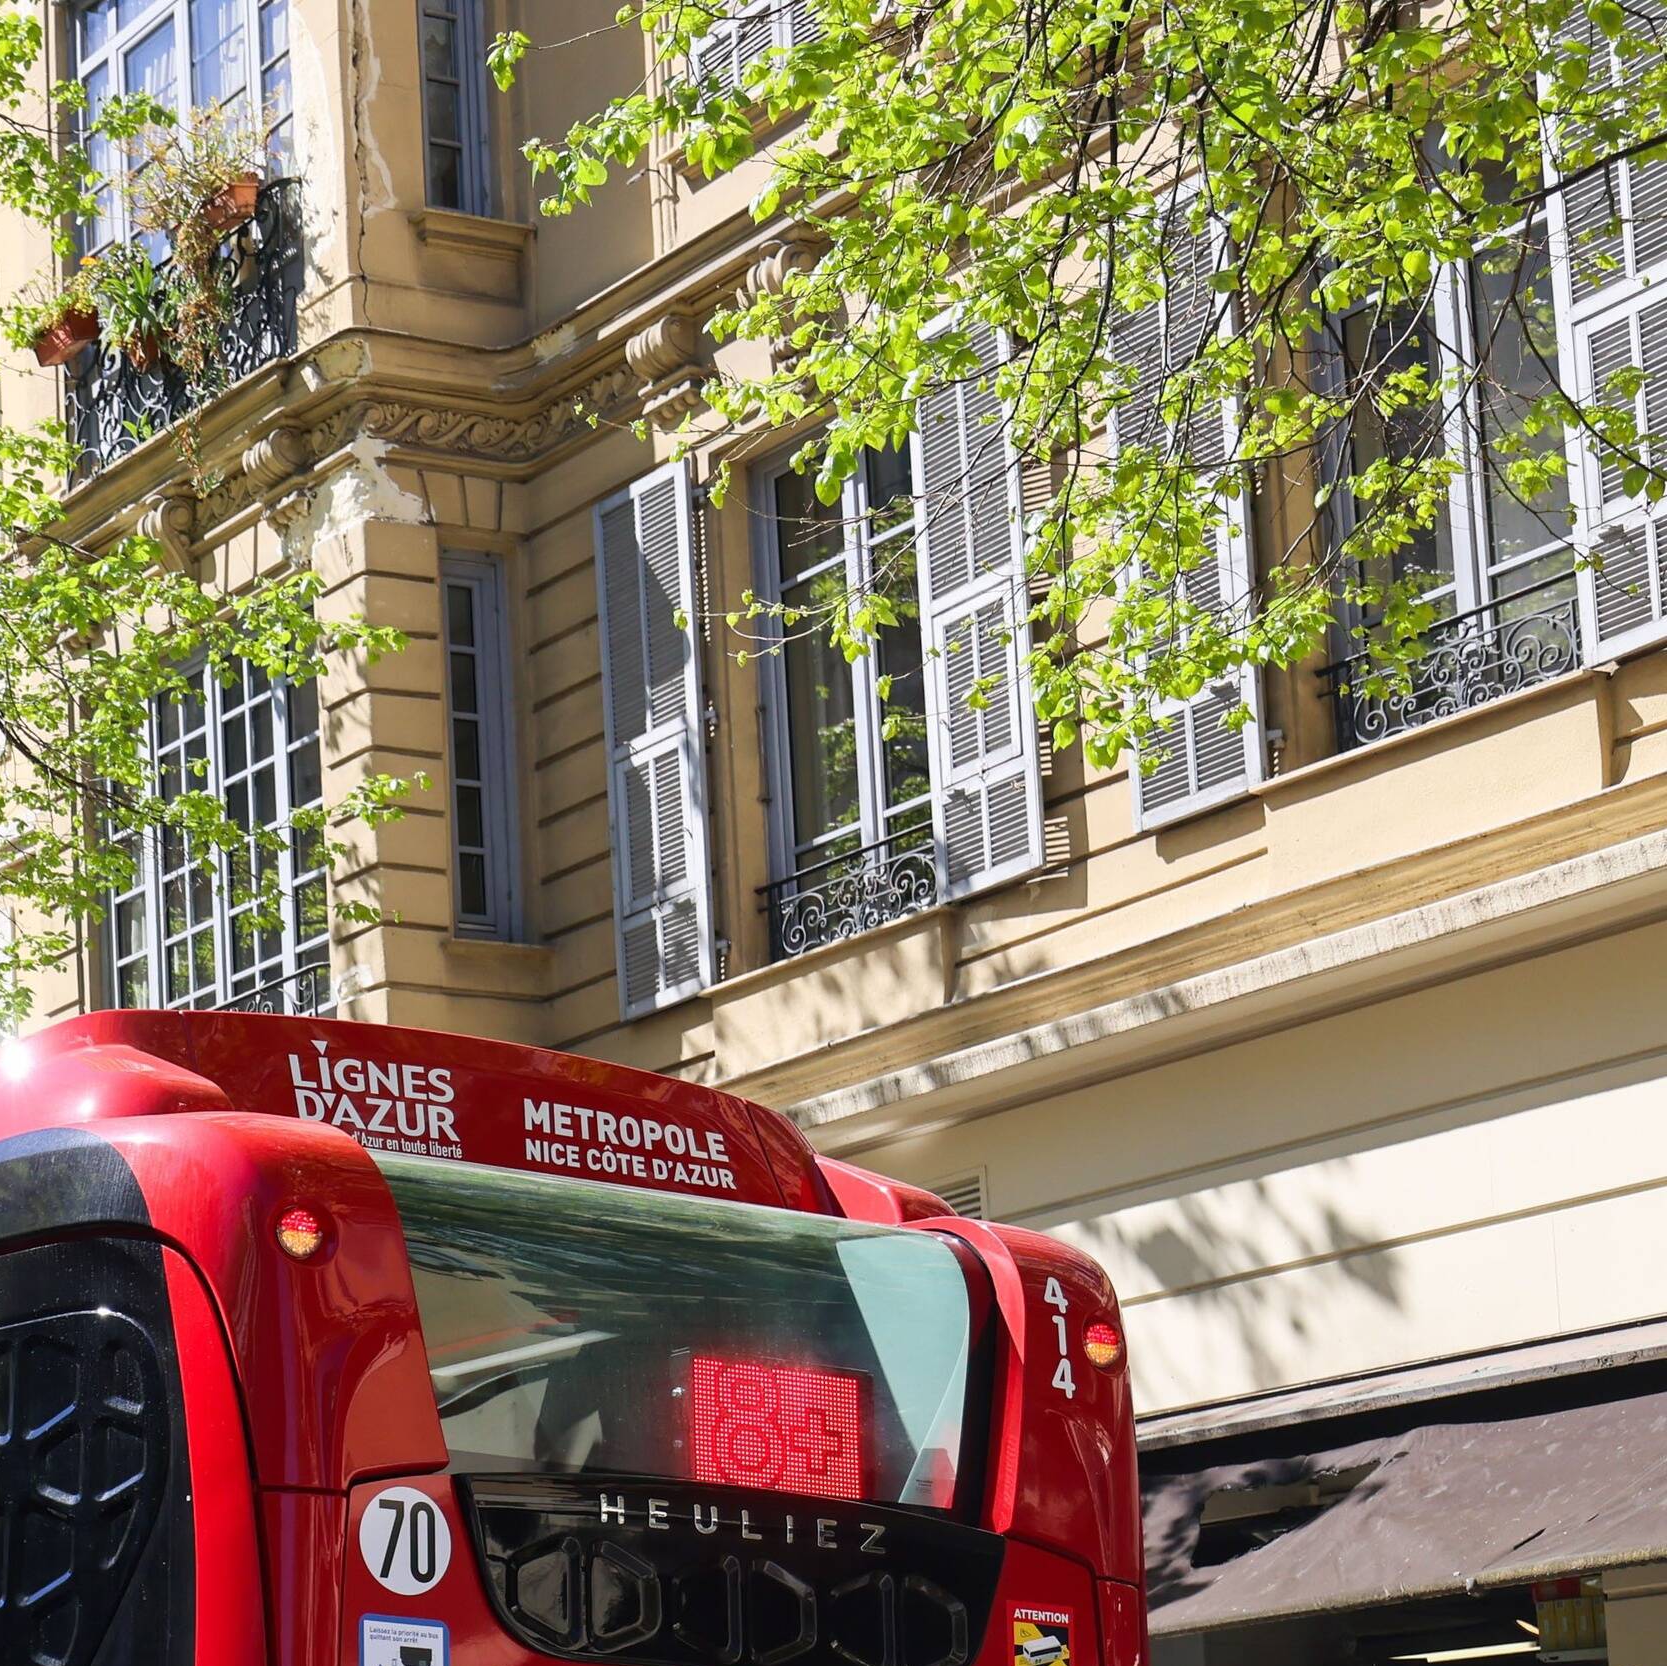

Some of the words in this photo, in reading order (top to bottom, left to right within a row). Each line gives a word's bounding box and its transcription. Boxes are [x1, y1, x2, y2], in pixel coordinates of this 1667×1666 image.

[387, 1139, 399, 1151] en
[401, 1138, 427, 1154] toute
[429, 1141, 462, 1158] liberté
[523, 1098, 730, 1163] METROPOLE
[525, 1138, 580, 1169] NICE
[586, 1145, 647, 1178] CÔTE
[652, 1158, 737, 1190] D'AZUR
[378, 1499, 436, 1584] 70
[599, 1492, 886, 1554] HEULIEZ
[1013, 1608, 1069, 1624] ATTENTION
